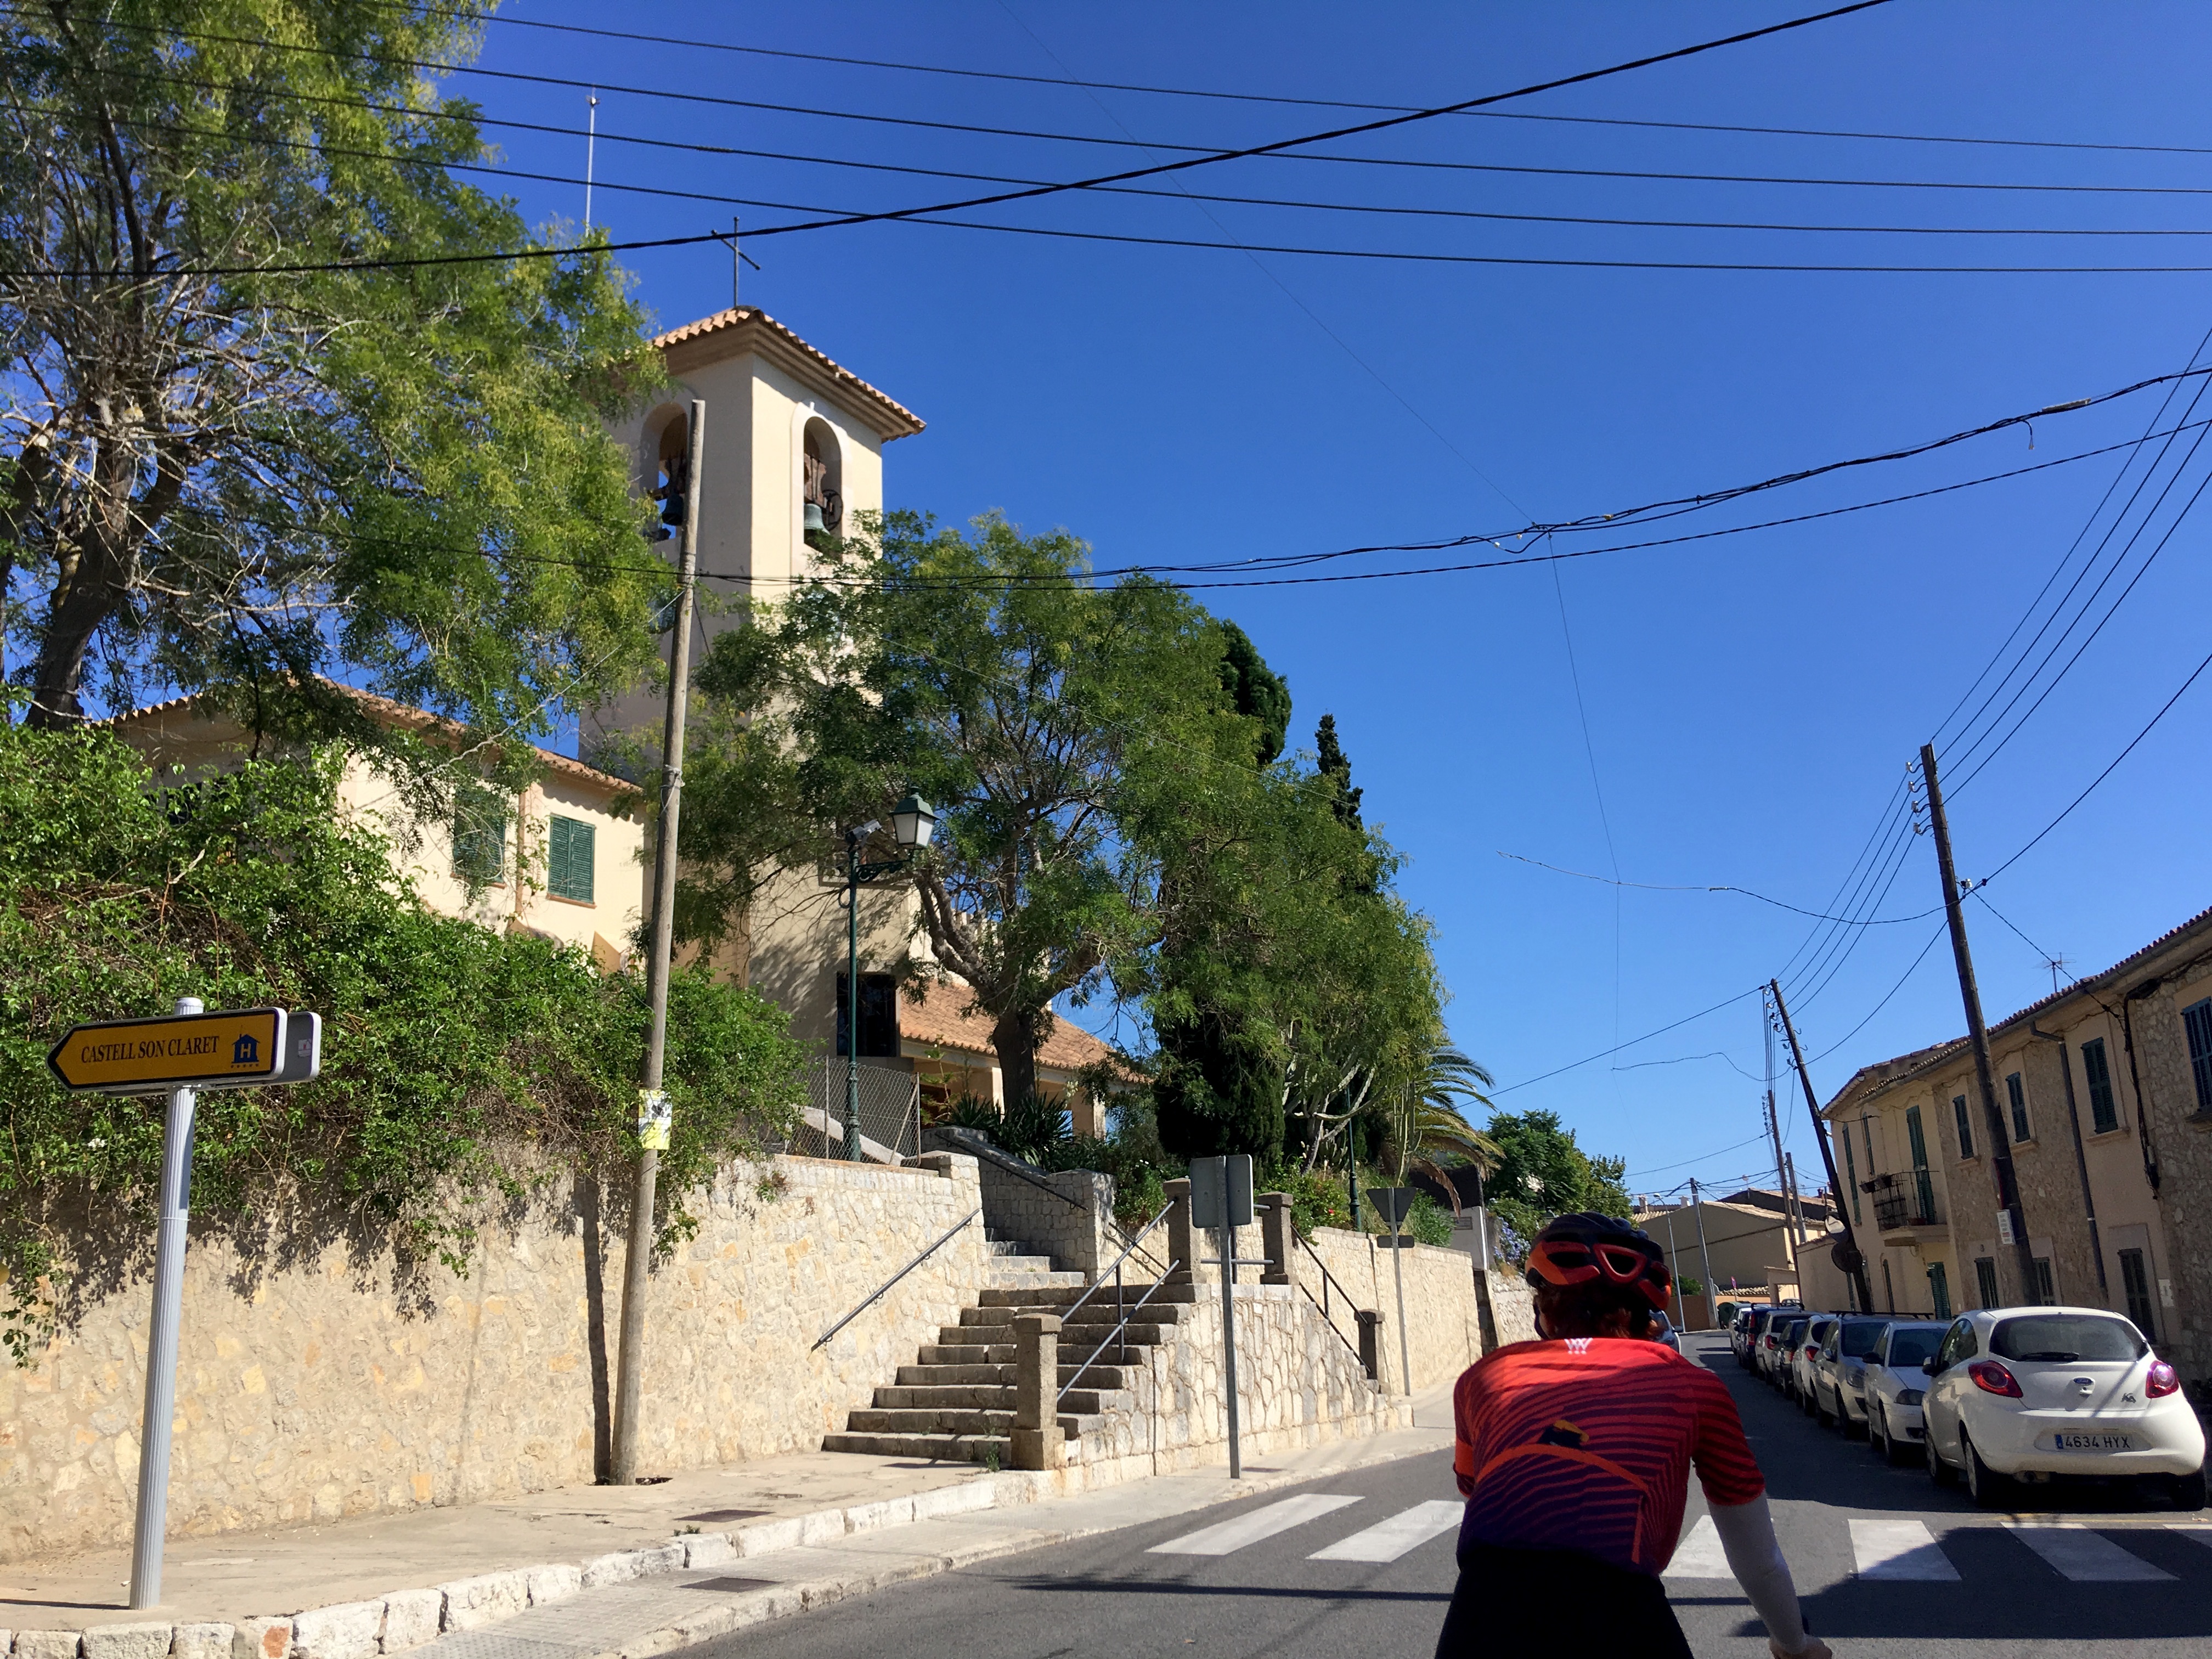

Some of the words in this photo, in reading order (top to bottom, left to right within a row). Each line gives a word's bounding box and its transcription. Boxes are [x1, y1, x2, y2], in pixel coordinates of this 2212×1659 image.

[81, 1042, 136, 1063] CASTELL
[138, 1040, 165, 1059] SON
[168, 1036, 219, 1057] CLARET
[240, 1043, 251, 1059] H
[2066, 1436, 2100, 1448] 4634
[2103, 1436, 2131, 1449] HYX
